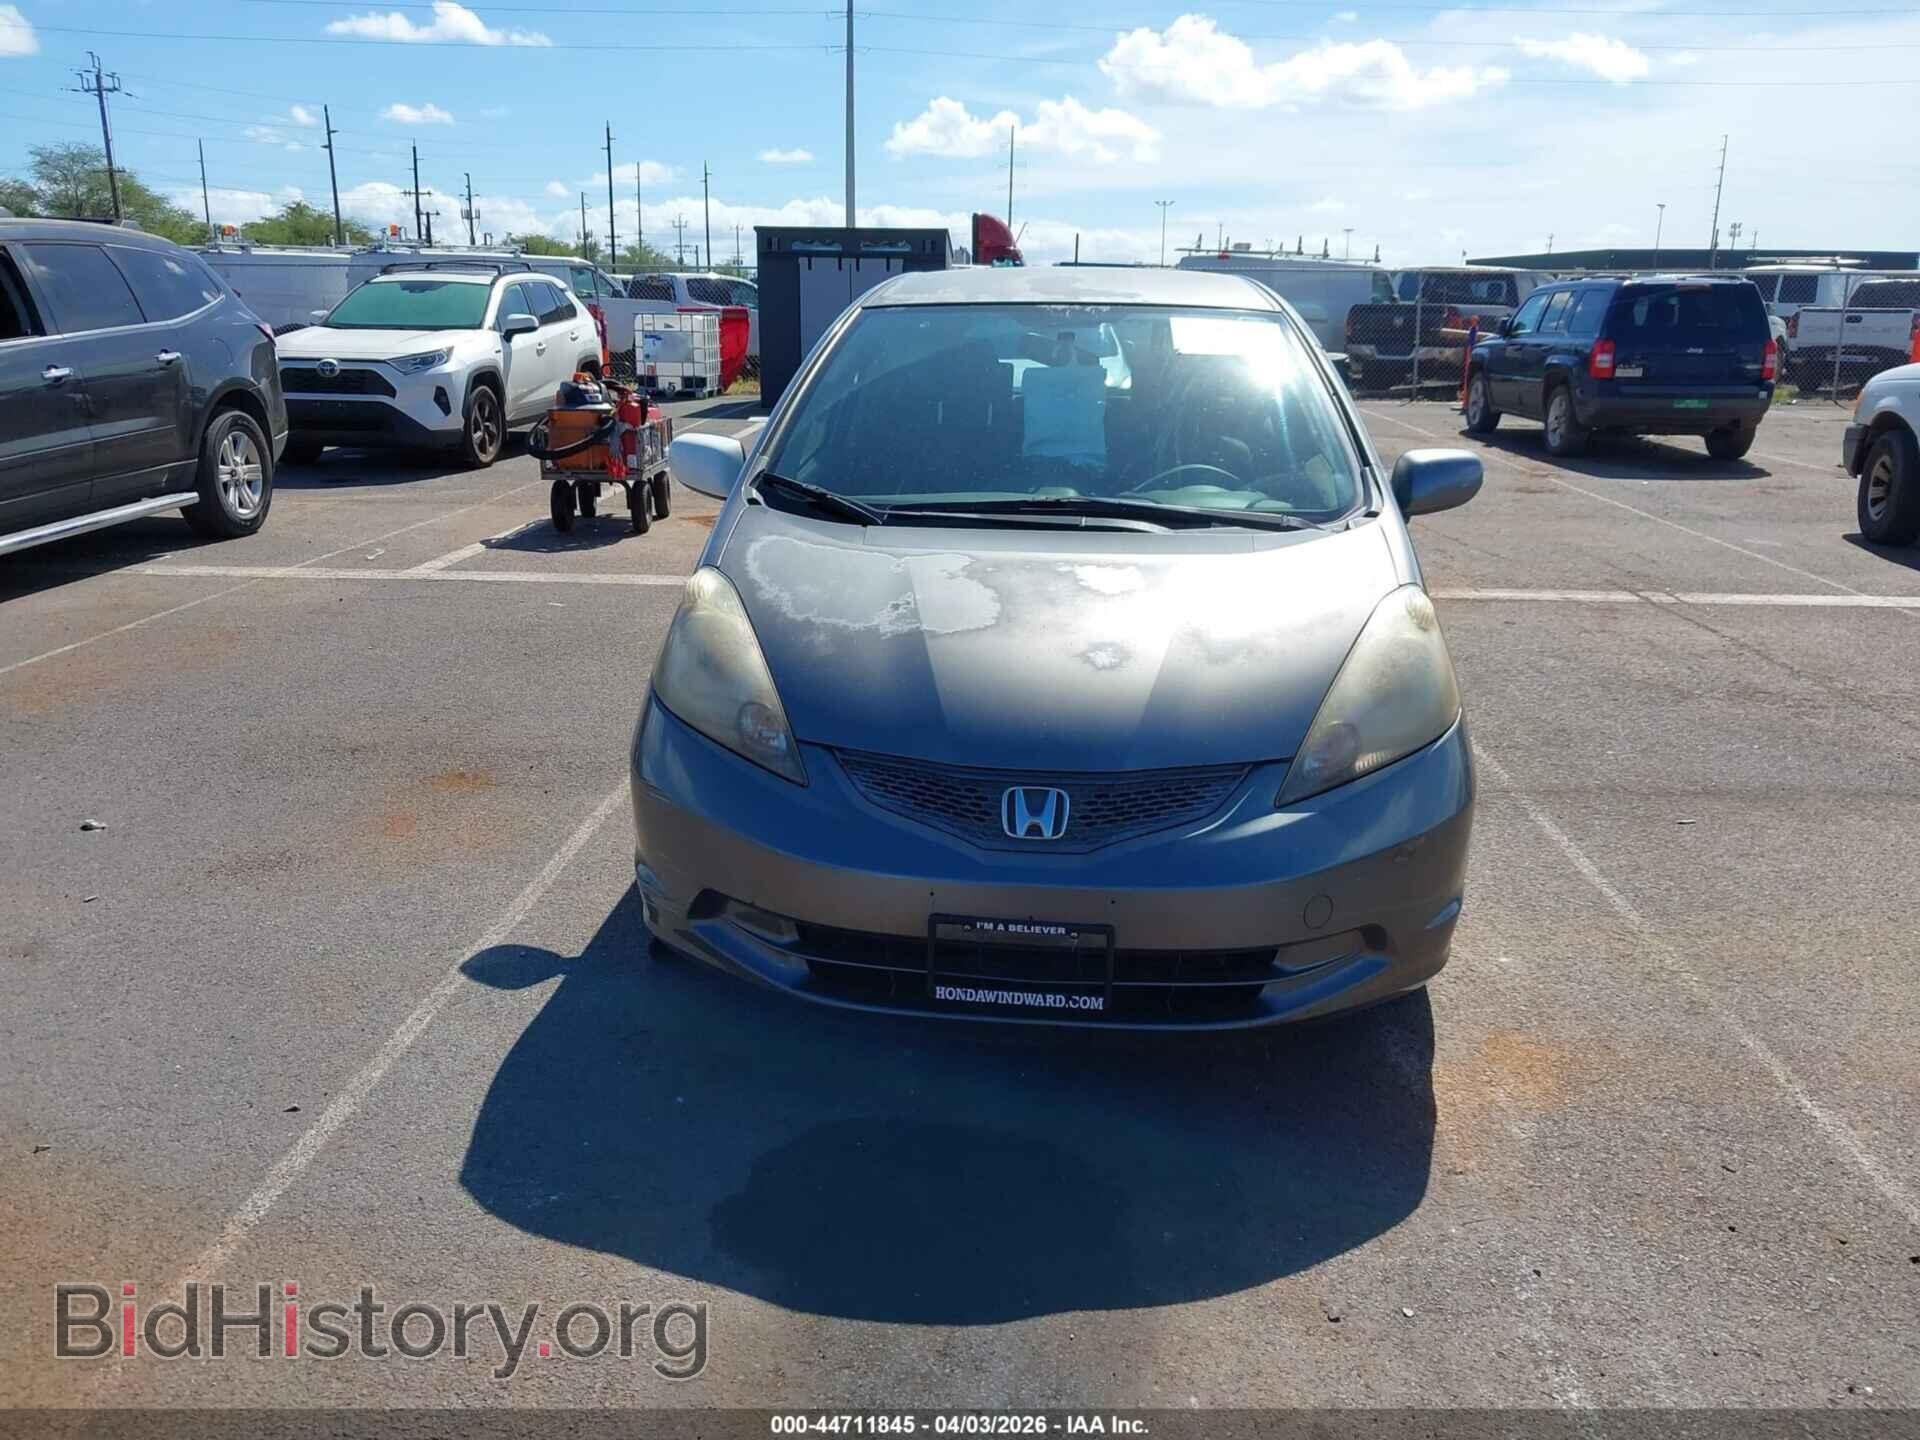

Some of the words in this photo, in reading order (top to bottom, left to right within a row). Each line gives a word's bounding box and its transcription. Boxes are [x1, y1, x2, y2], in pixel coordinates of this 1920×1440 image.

[976, 921, 994, 931] I'M
[996, 922, 1005, 932] A
[1008, 924, 1066, 935] BELIEVER
[935, 985, 1104, 1010] HONDAWINDWARD.COM
